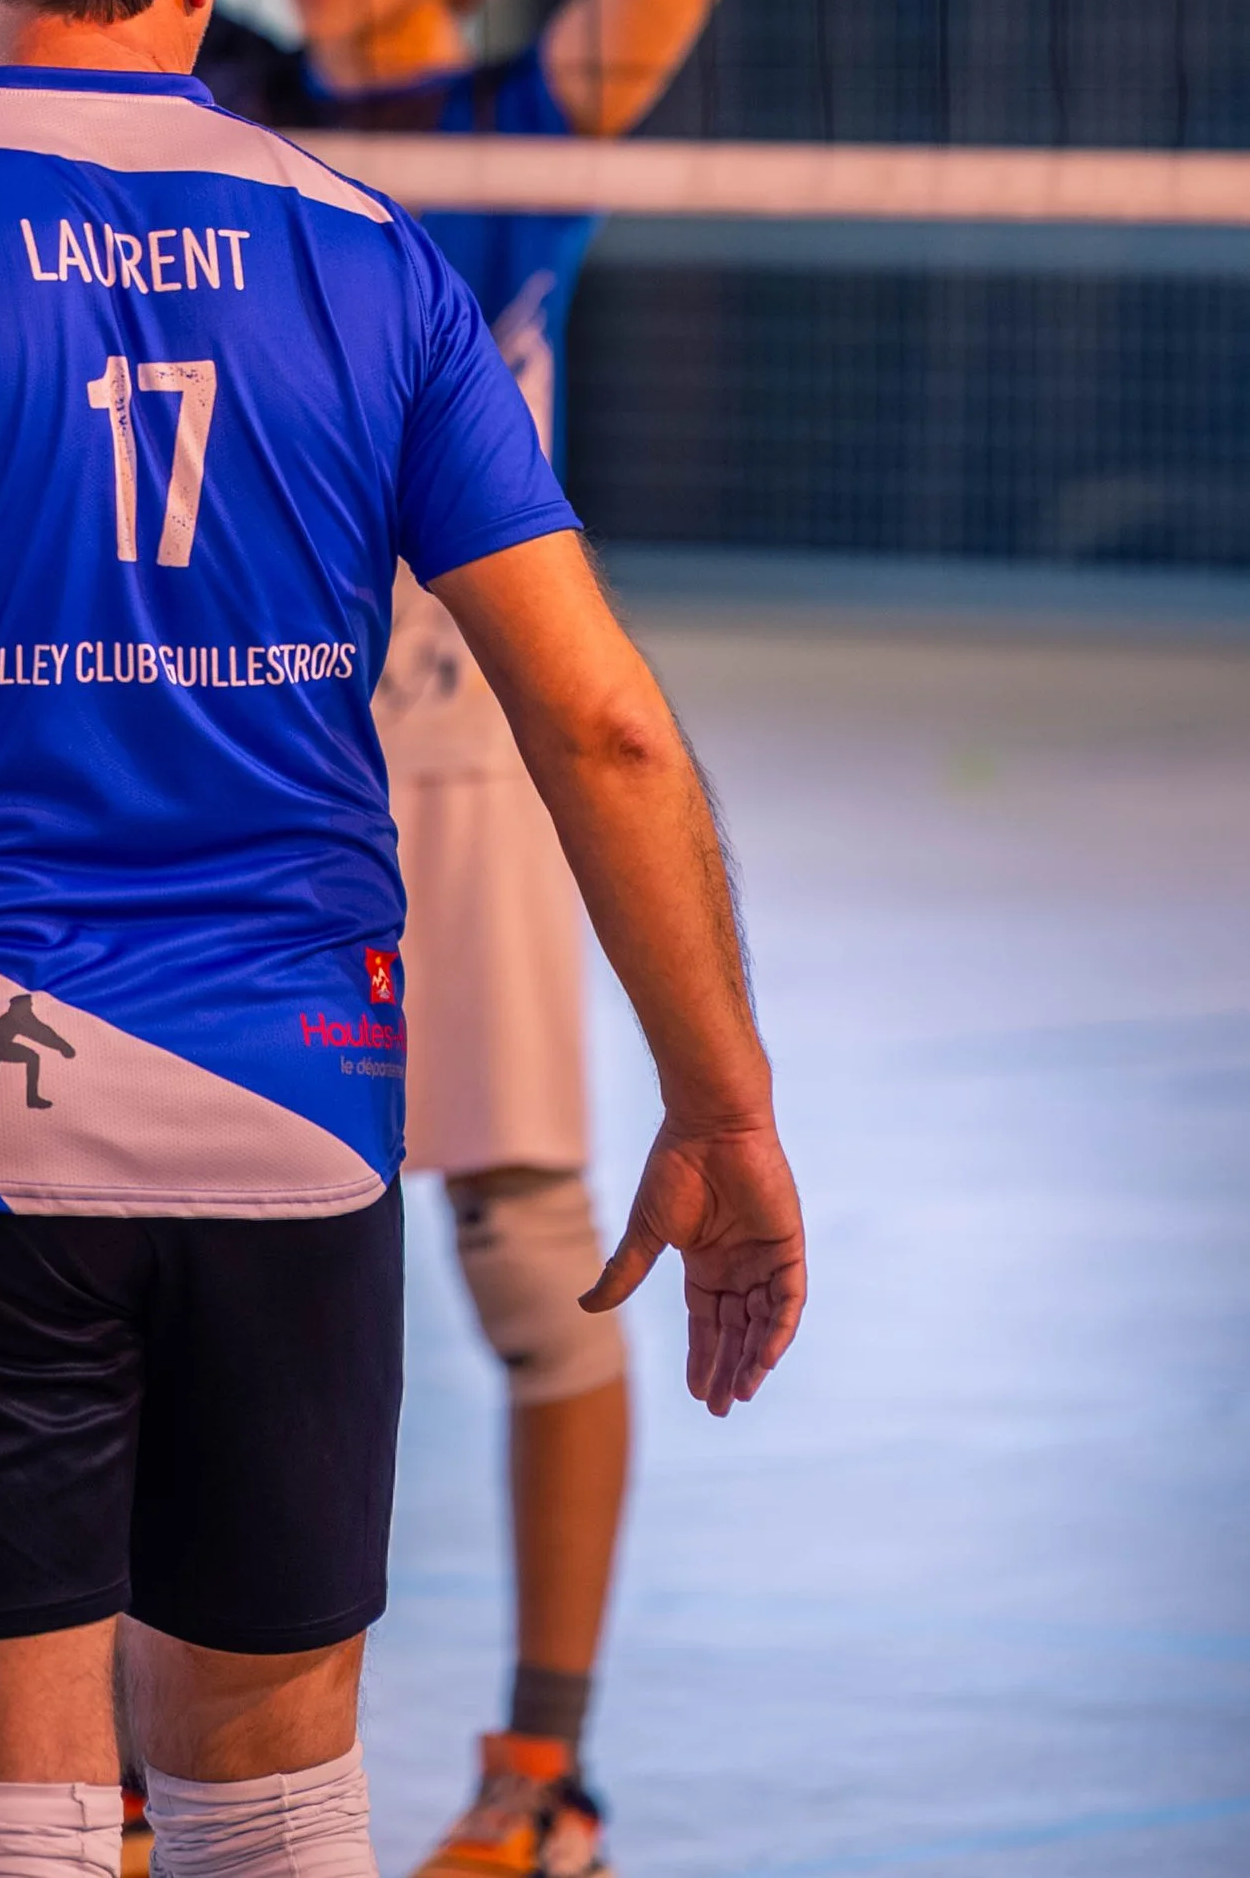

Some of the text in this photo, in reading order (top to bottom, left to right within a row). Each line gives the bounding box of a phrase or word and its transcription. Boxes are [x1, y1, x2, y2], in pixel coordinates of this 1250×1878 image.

[21, 218, 250, 294] LAURENT
[87, 355, 217, 568] 17
[75, 640, 159, 684] CLUB
[158, 642, 356, 688] GUILLESTROIS
